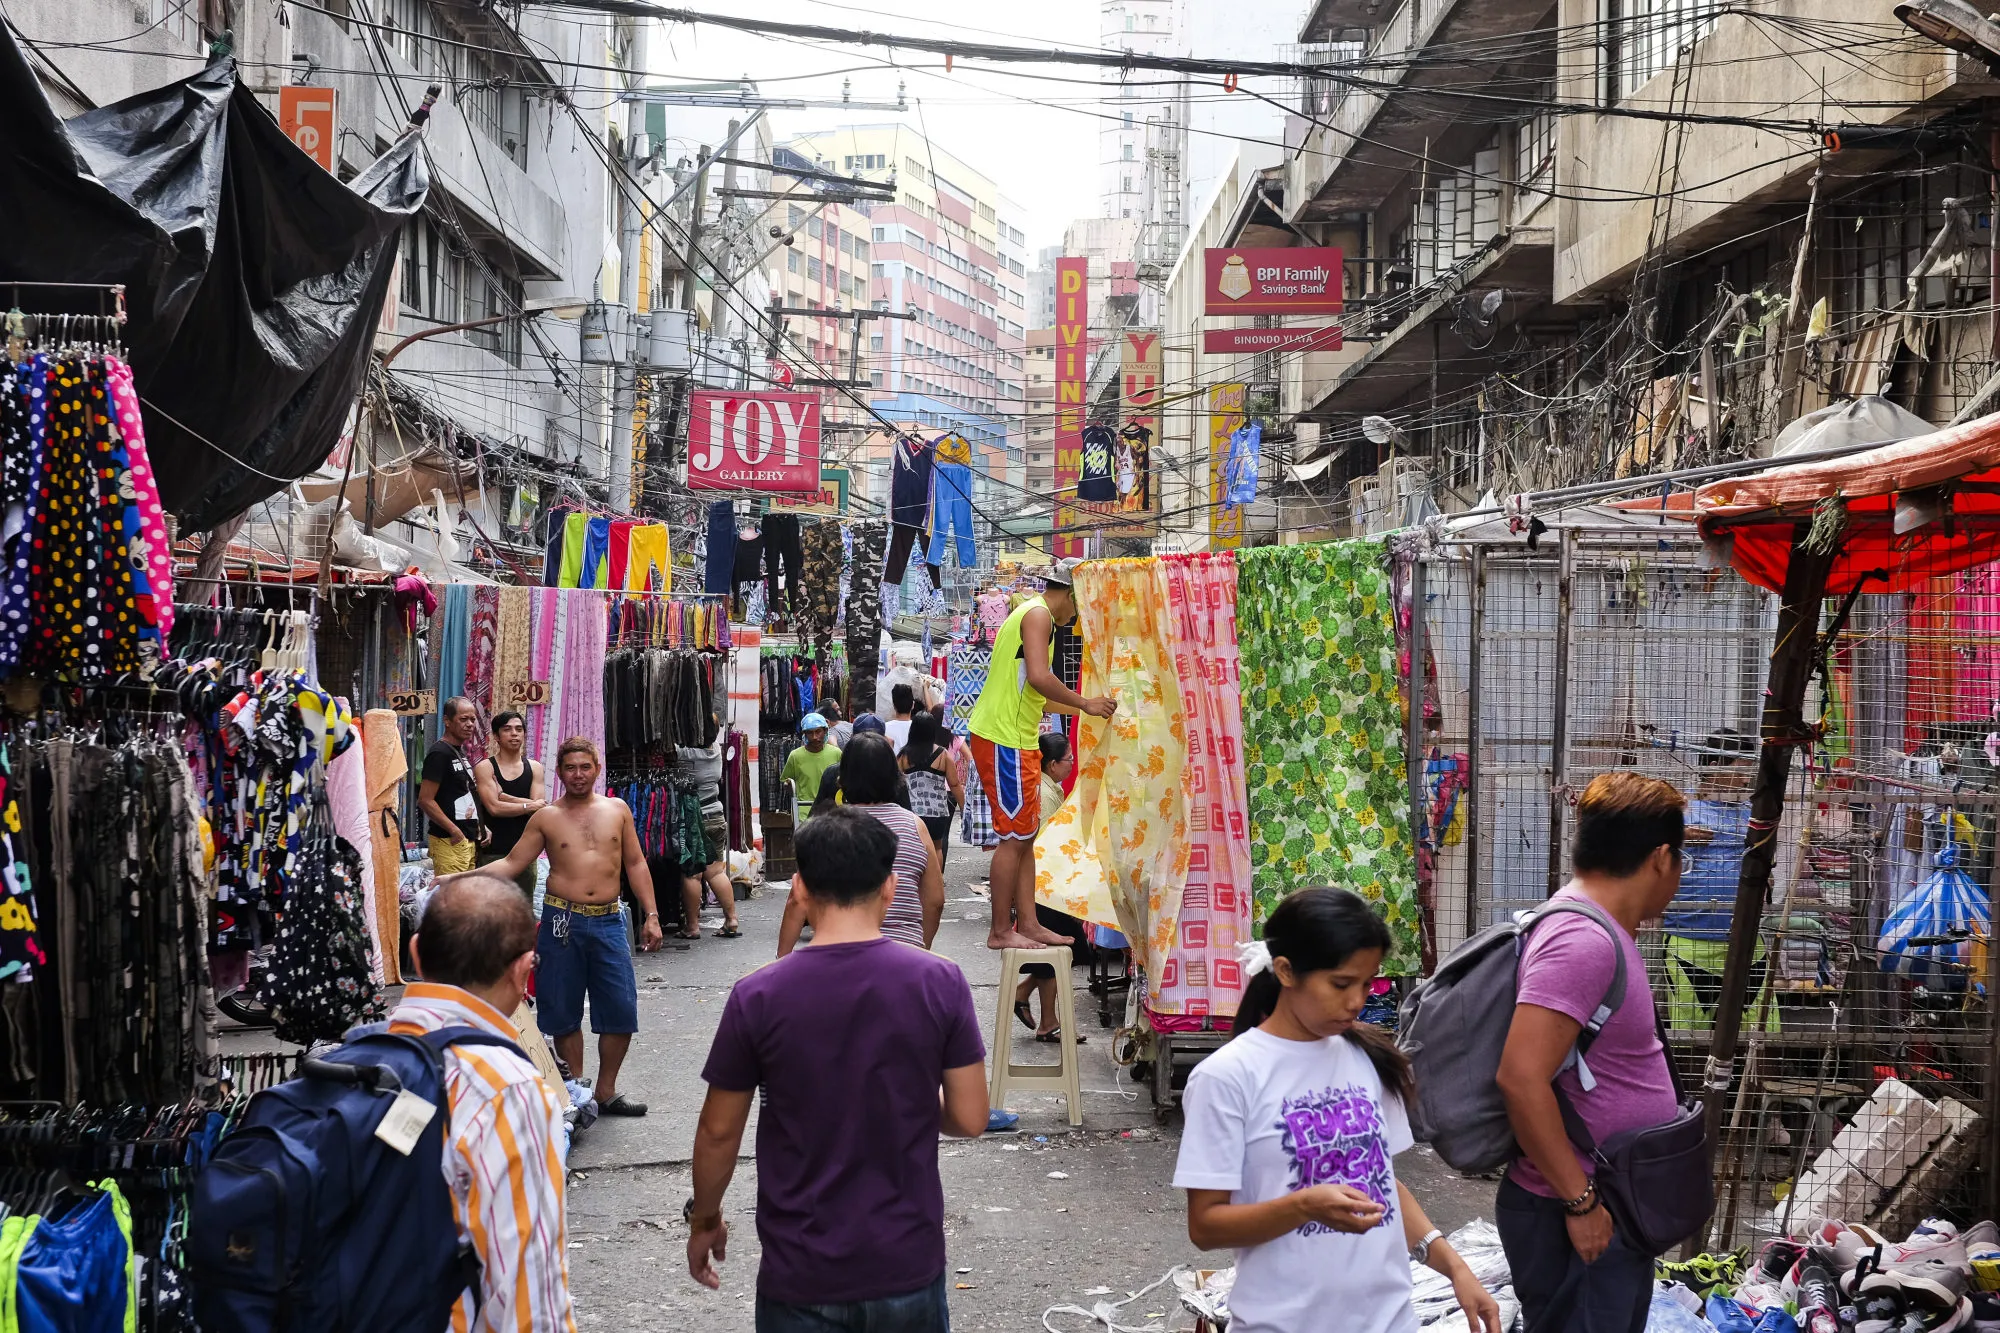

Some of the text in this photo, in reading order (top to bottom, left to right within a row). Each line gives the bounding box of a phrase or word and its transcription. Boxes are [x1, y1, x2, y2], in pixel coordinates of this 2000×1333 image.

[1257, 266, 1330, 284] BPI Family
[1261, 284, 1326, 297] Savings Bank
[1234, 336, 1280, 345] BINONDO
[1060, 269, 1082, 431] DIVINE
[1124, 363, 1158, 371] YANGCO
[692, 399, 815, 472] JOY
[719, 469, 788, 481] GALLERY
[512, 684, 544, 702] 20
[392, 695, 420, 711] 20
[1284, 1098, 1381, 1149] PUER
[1296, 1137, 1386, 1187] TOGA
